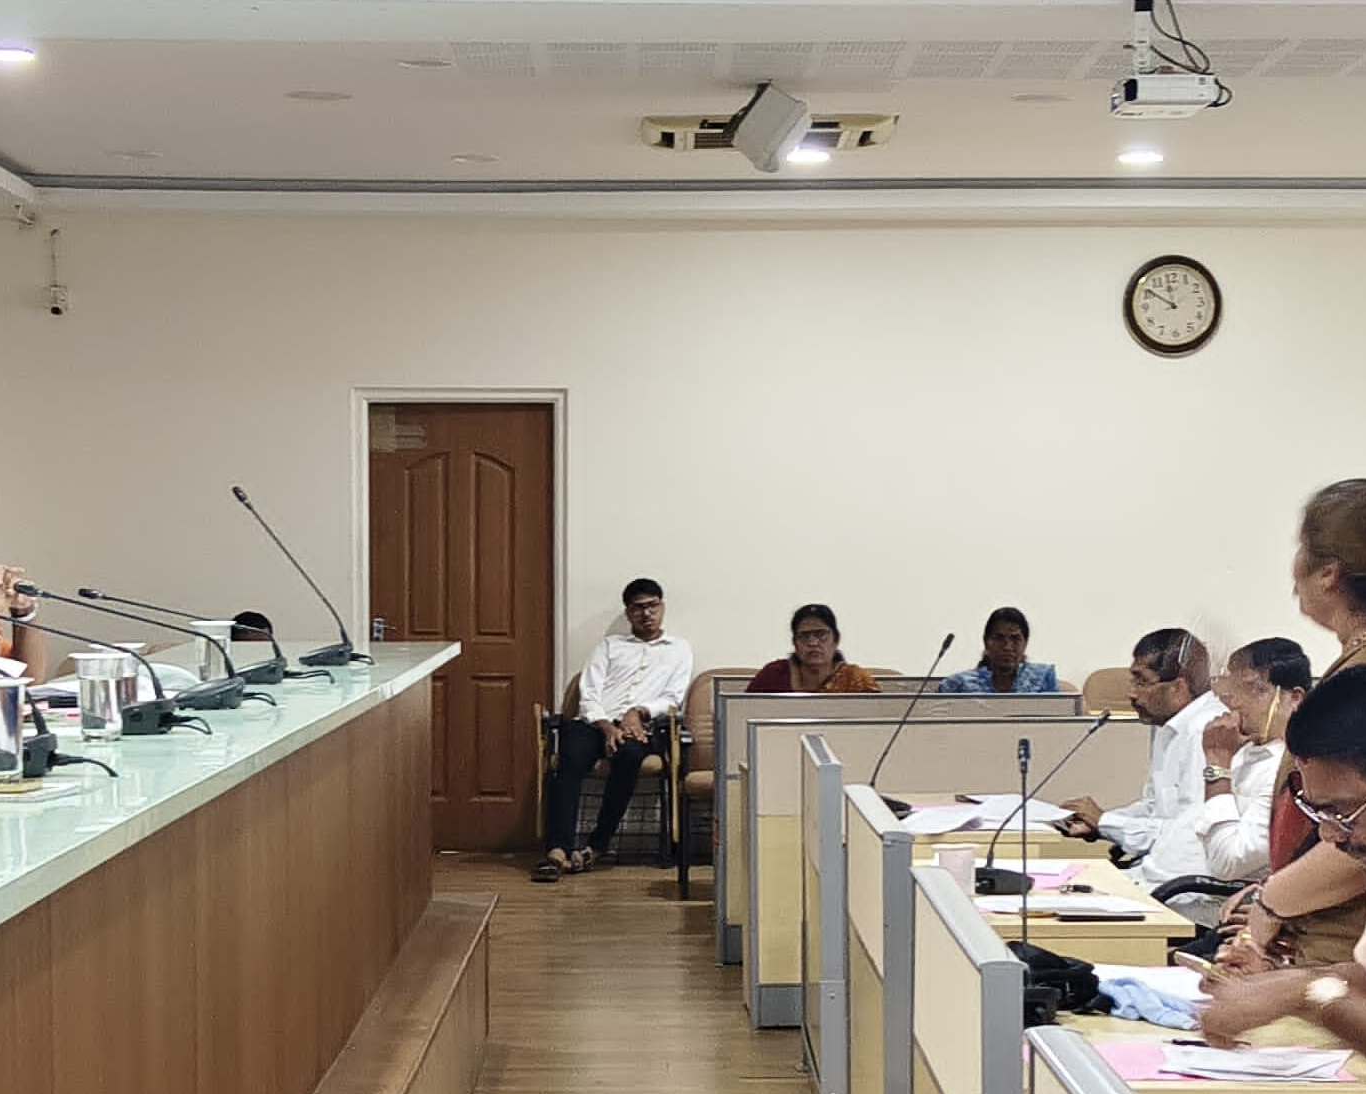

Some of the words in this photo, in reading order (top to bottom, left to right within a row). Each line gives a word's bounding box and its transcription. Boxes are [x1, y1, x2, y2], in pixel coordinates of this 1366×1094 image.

[1152, 277, 1163, 288] 11
[1164, 272, 1178, 284] 12
[1192, 282, 1201, 294] 2
